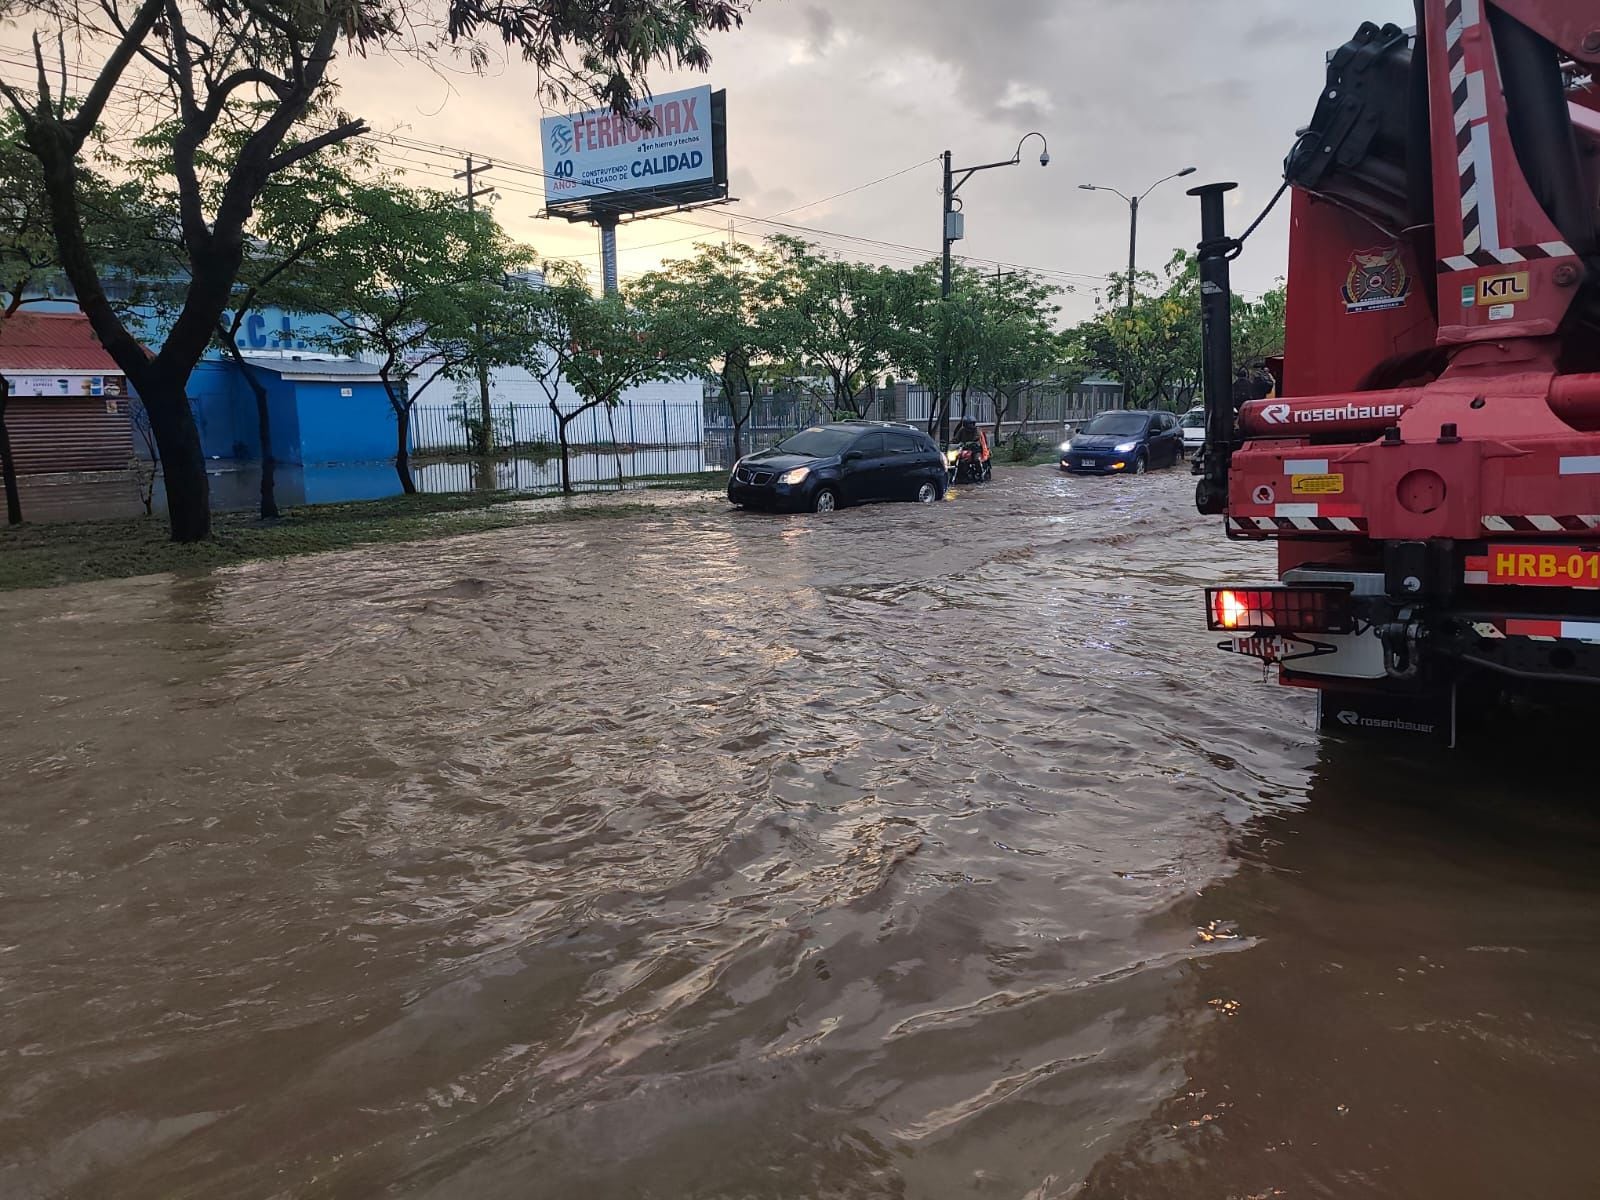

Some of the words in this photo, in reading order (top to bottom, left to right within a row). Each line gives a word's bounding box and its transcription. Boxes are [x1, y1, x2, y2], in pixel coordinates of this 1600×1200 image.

[573, 97, 699, 153] FERROMAX
[655, 140, 673, 149] hierro
[678, 136, 700, 145] techos
[554, 159, 574, 178] 40
[631, 150, 703, 178] CALIDAD
[582, 164, 628, 178] CONSTRUYENDO
[619, 173, 628, 181] DE
[1483, 277, 1524, 297] KTL
[1294, 402, 1404, 423] rosenbauer
[1496, 553, 1599, 579] HRB-01
[1360, 717, 1434, 733] rosenbauer
